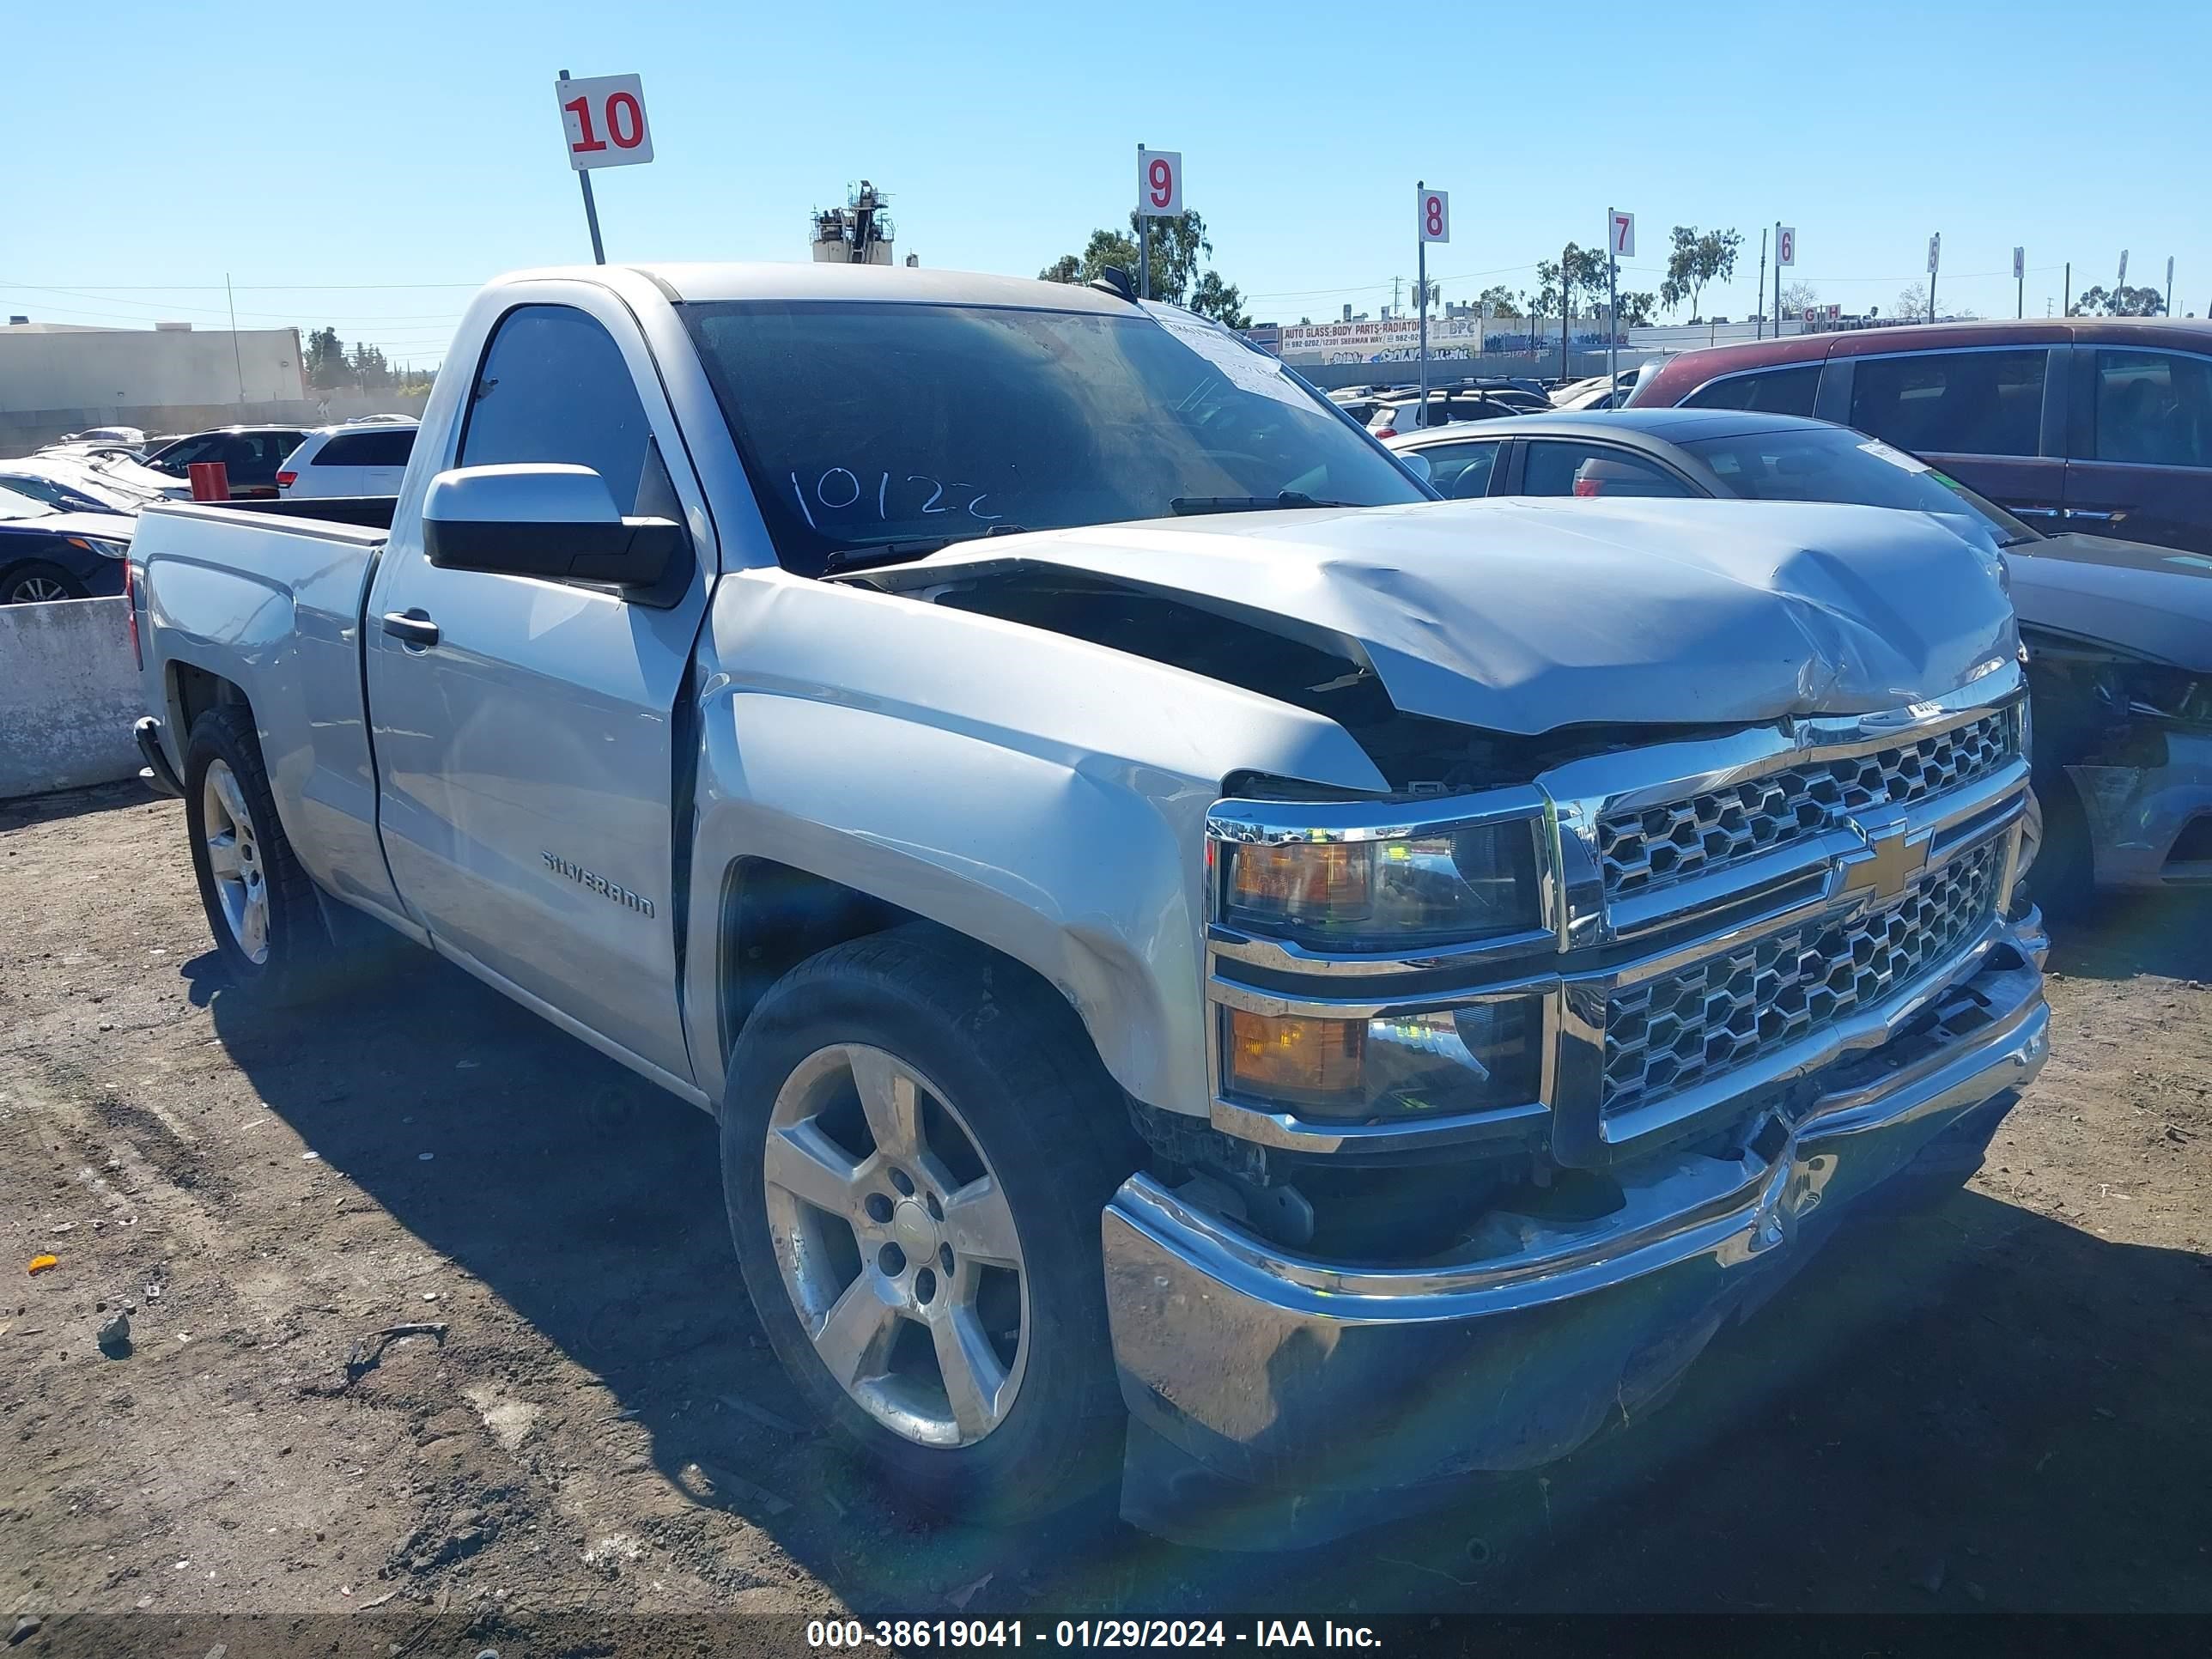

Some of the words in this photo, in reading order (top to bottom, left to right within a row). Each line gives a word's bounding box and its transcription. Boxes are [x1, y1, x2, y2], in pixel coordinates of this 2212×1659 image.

[565, 92, 644, 153] 10
[1149, 159, 1172, 208] 9
[1426, 196, 1443, 236] 8
[1615, 216, 1630, 251] 7
[1781, 232, 1791, 261] 6
[1929, 241, 1937, 268] 5
[2015, 251, 2022, 275] 4
[1805, 308, 1814, 321] G
[1829, 306, 1838, 319] H
[1285, 328, 1304, 339] AUTO
[1340, 336, 1369, 345] SHERMAN
[1395, 333, 1424, 342] 982-02
[541, 849, 654, 919] SILVERADO
